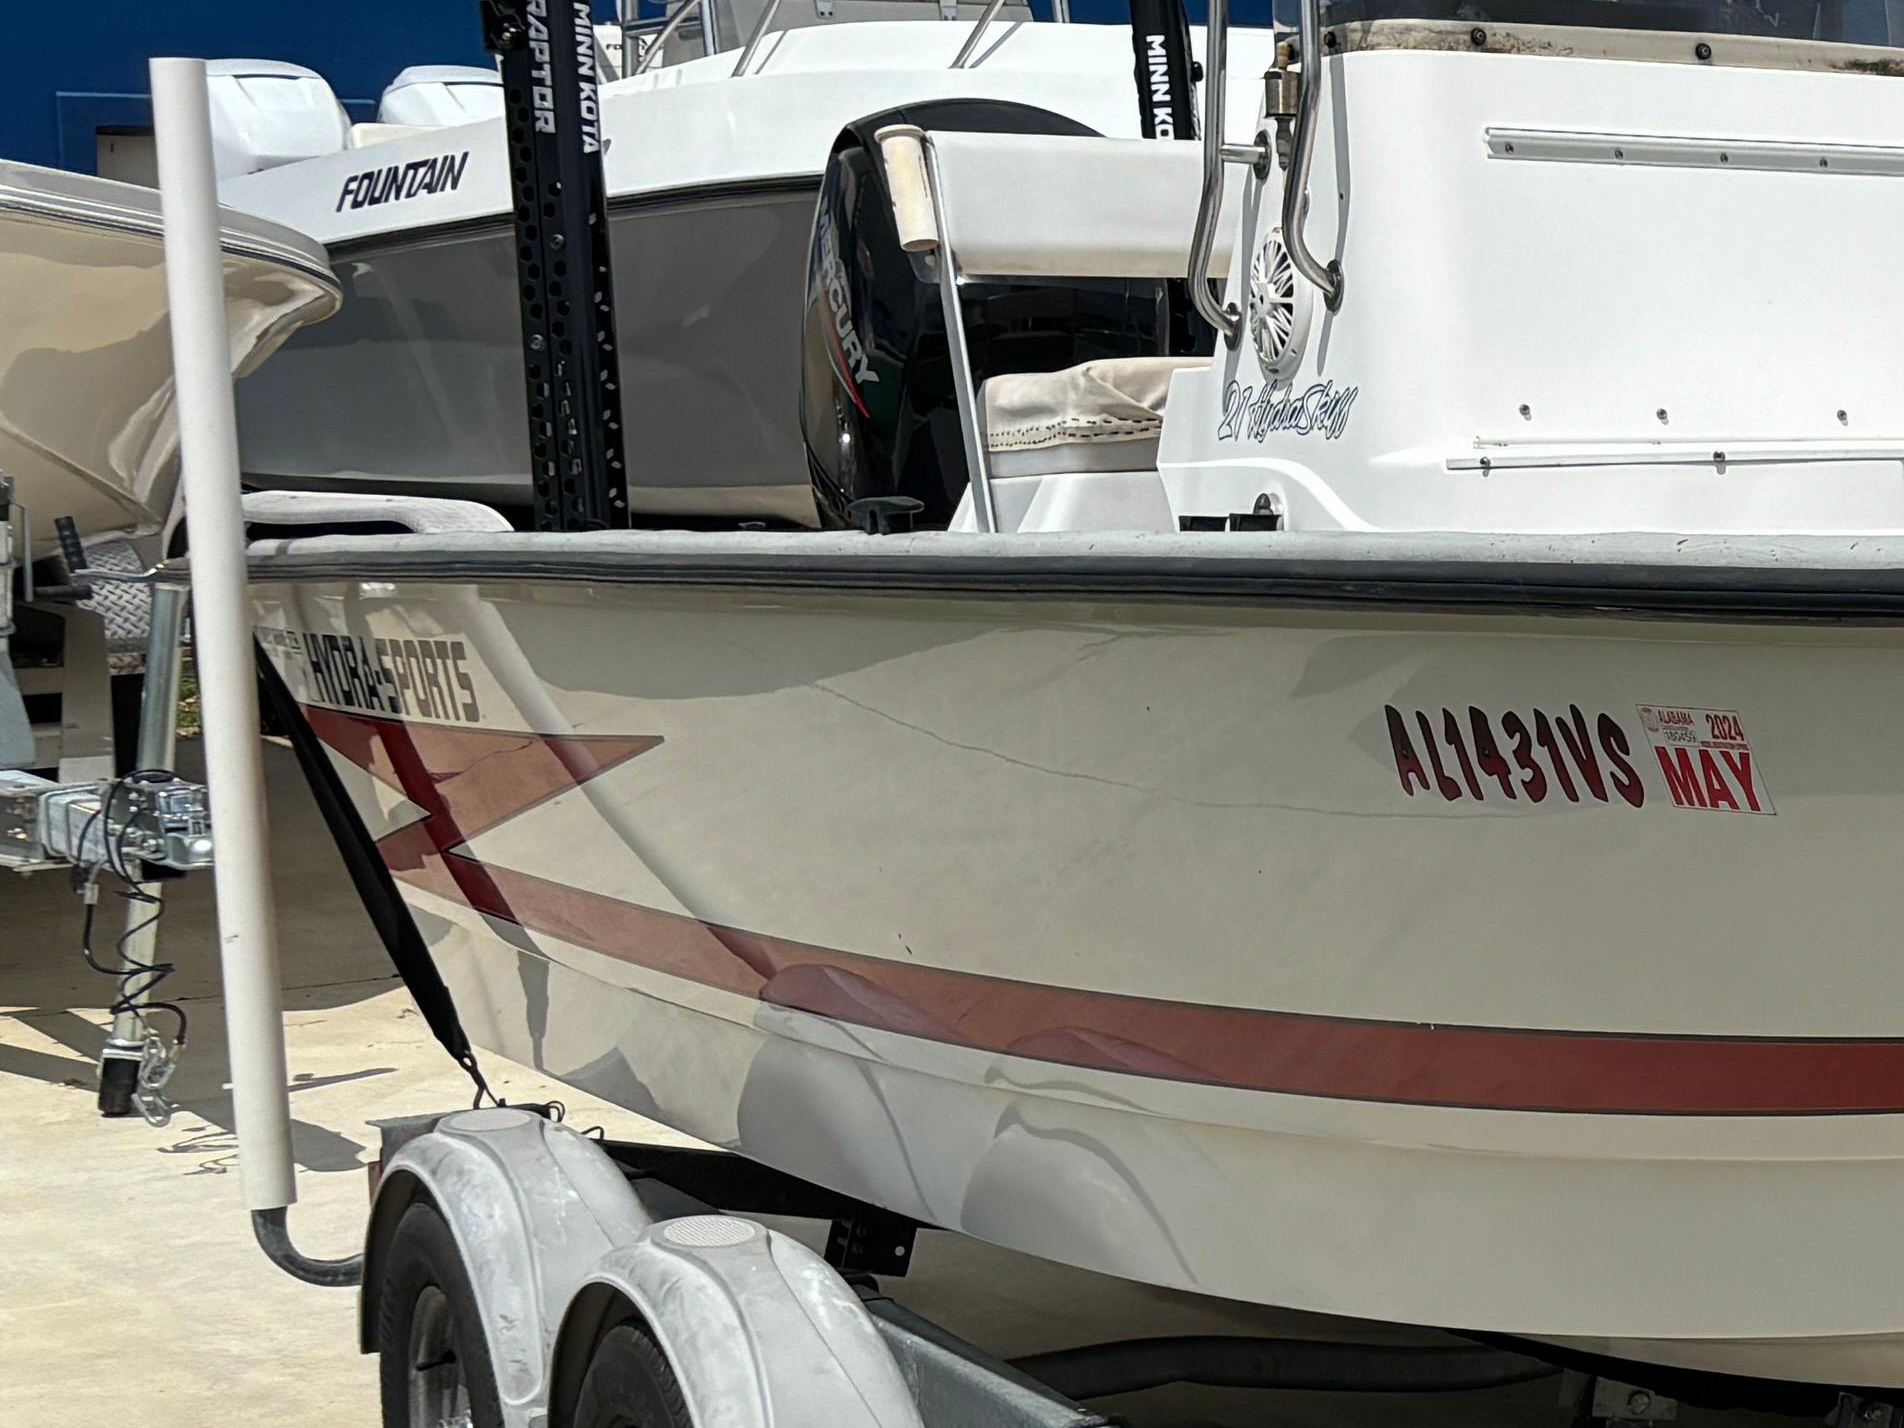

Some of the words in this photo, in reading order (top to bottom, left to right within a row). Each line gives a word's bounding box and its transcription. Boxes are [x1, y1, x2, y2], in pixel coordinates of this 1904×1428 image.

[573, 2, 595, 76] MINN
[1146, 35, 1171, 102] MINN
[578, 81, 600, 154] KOTA
[335, 151, 470, 213] FOUNTAIN
[1218, 380, 1253, 442] 21
[1384, 704, 1644, 808] AL1431VS
[1705, 714, 1745, 741] 2024
[1654, 746, 1761, 812] MAY
